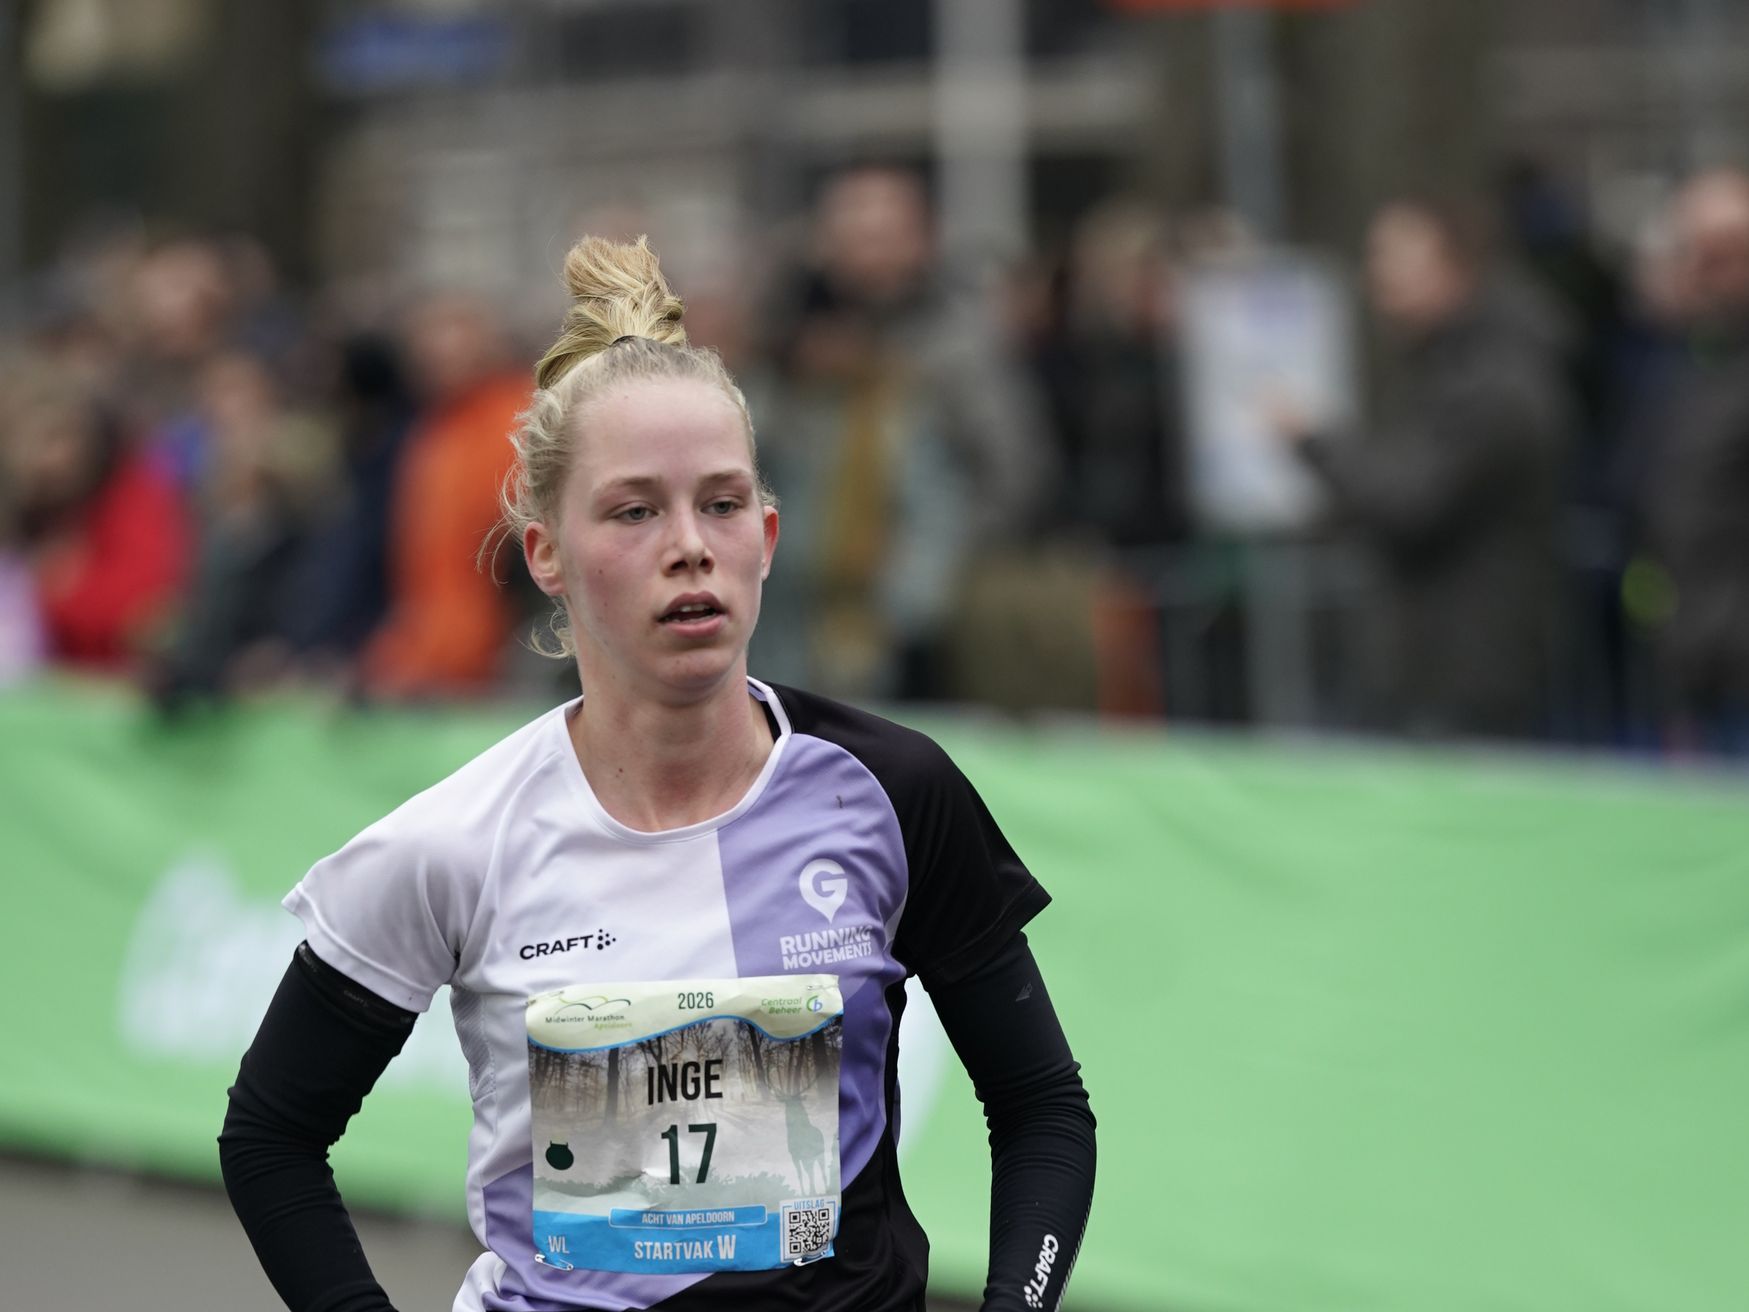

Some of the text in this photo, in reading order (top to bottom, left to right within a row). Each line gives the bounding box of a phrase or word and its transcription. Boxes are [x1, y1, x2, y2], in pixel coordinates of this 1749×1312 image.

[519, 934, 594, 960] CRAFT
[780, 925, 873, 955] RUNNING
[782, 941, 872, 970] MOVEMENTS
[677, 992, 715, 1010] 2026
[761, 997, 802, 1006] Centraal
[768, 1006, 802, 1014] Beheer
[545, 1014, 625, 1024] Midwinter Marathon
[647, 1059, 723, 1106] INGE
[660, 1122, 718, 1185] 17
[794, 1200, 825, 1210] UITSLAG
[641, 1211, 735, 1225] ACHT VAN APELDOORN
[548, 1234, 570, 1254] WL
[634, 1234, 737, 1260] STARTVAK W
[1030, 1233, 1059, 1297] CRAFT
